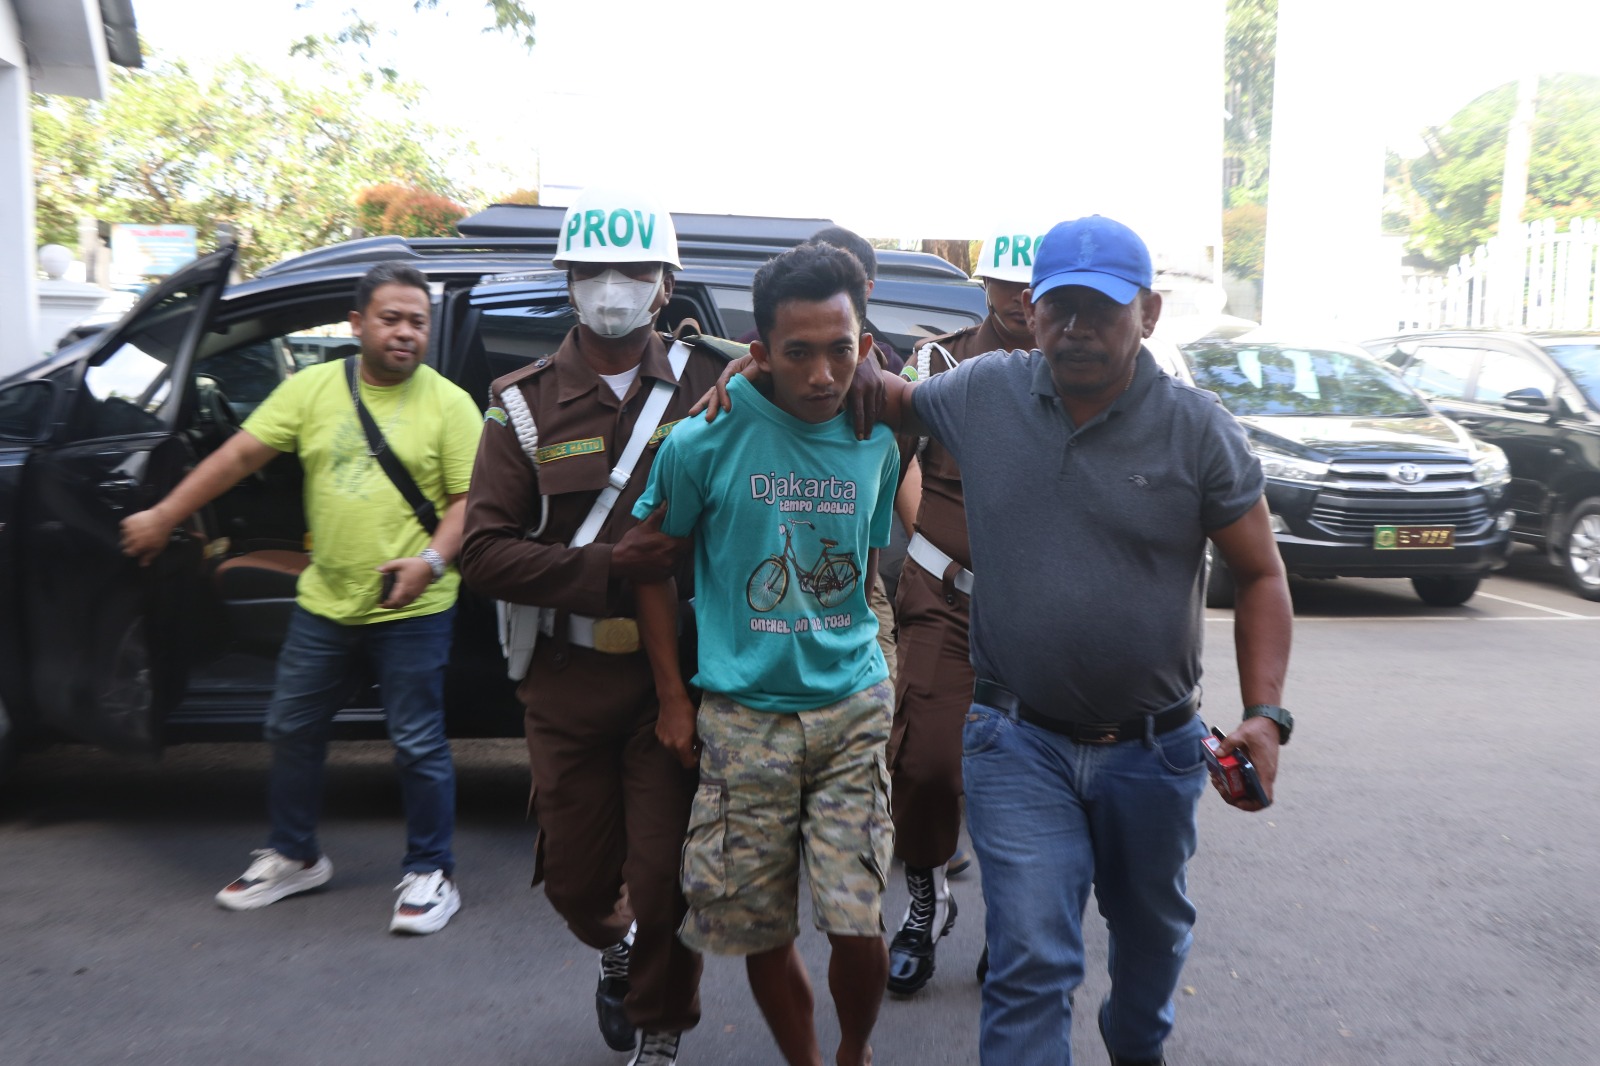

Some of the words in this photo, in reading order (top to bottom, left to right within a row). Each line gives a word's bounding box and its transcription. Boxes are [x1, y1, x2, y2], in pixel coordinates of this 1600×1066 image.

[565, 208, 656, 252] PROV
[750, 472, 857, 505] Djakarta
[824, 613, 851, 630] road
